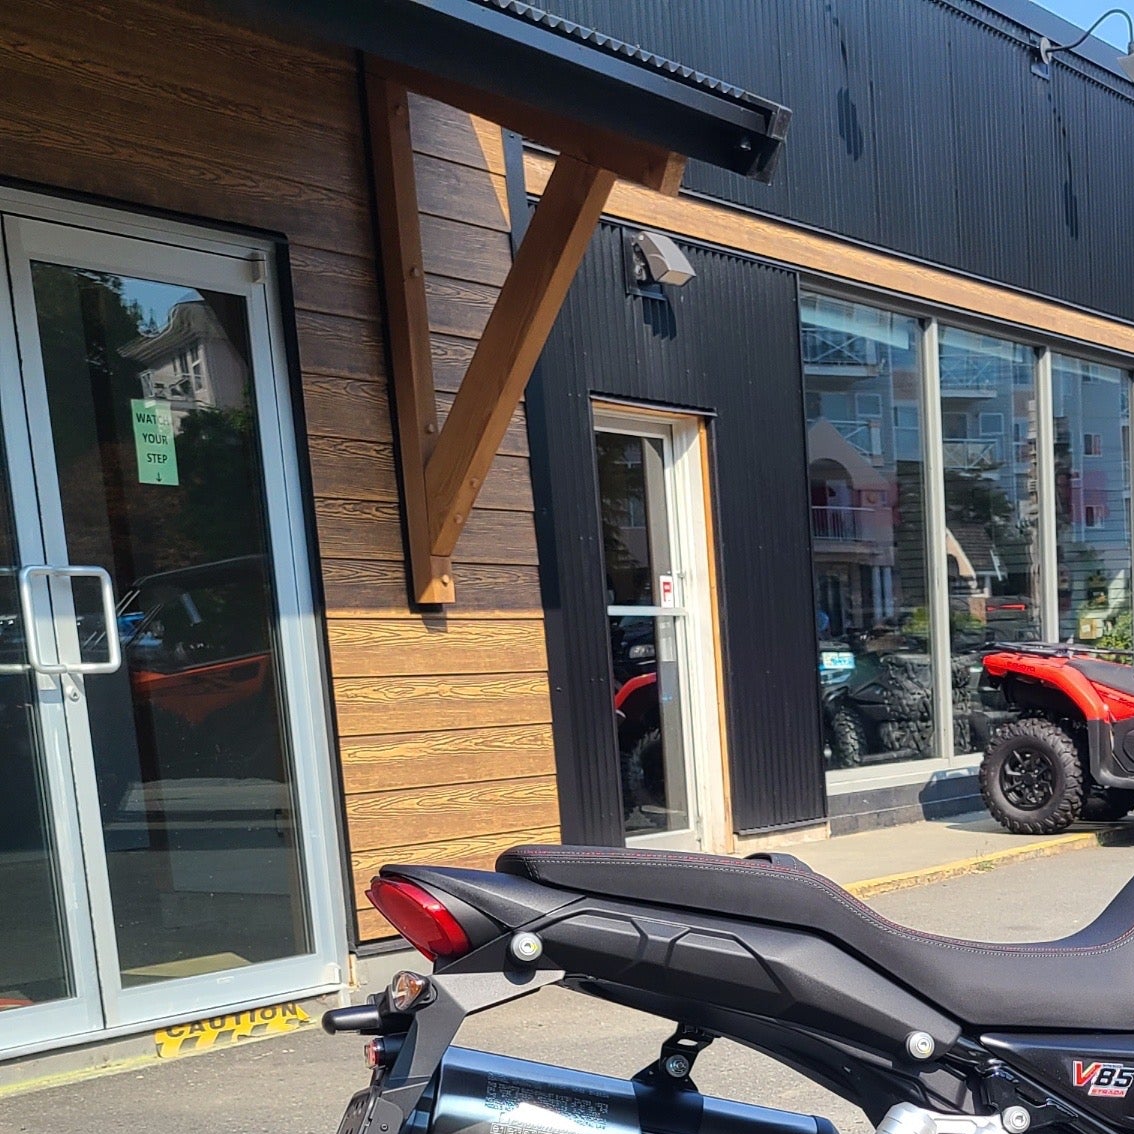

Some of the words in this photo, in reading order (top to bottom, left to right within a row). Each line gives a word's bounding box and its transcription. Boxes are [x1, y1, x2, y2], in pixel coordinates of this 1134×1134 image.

[135, 412, 170, 426] WATCH
[142, 432, 168, 445] YOUR
[146, 453, 168, 464] STEP
[165, 1001, 298, 1038] CAUTION
